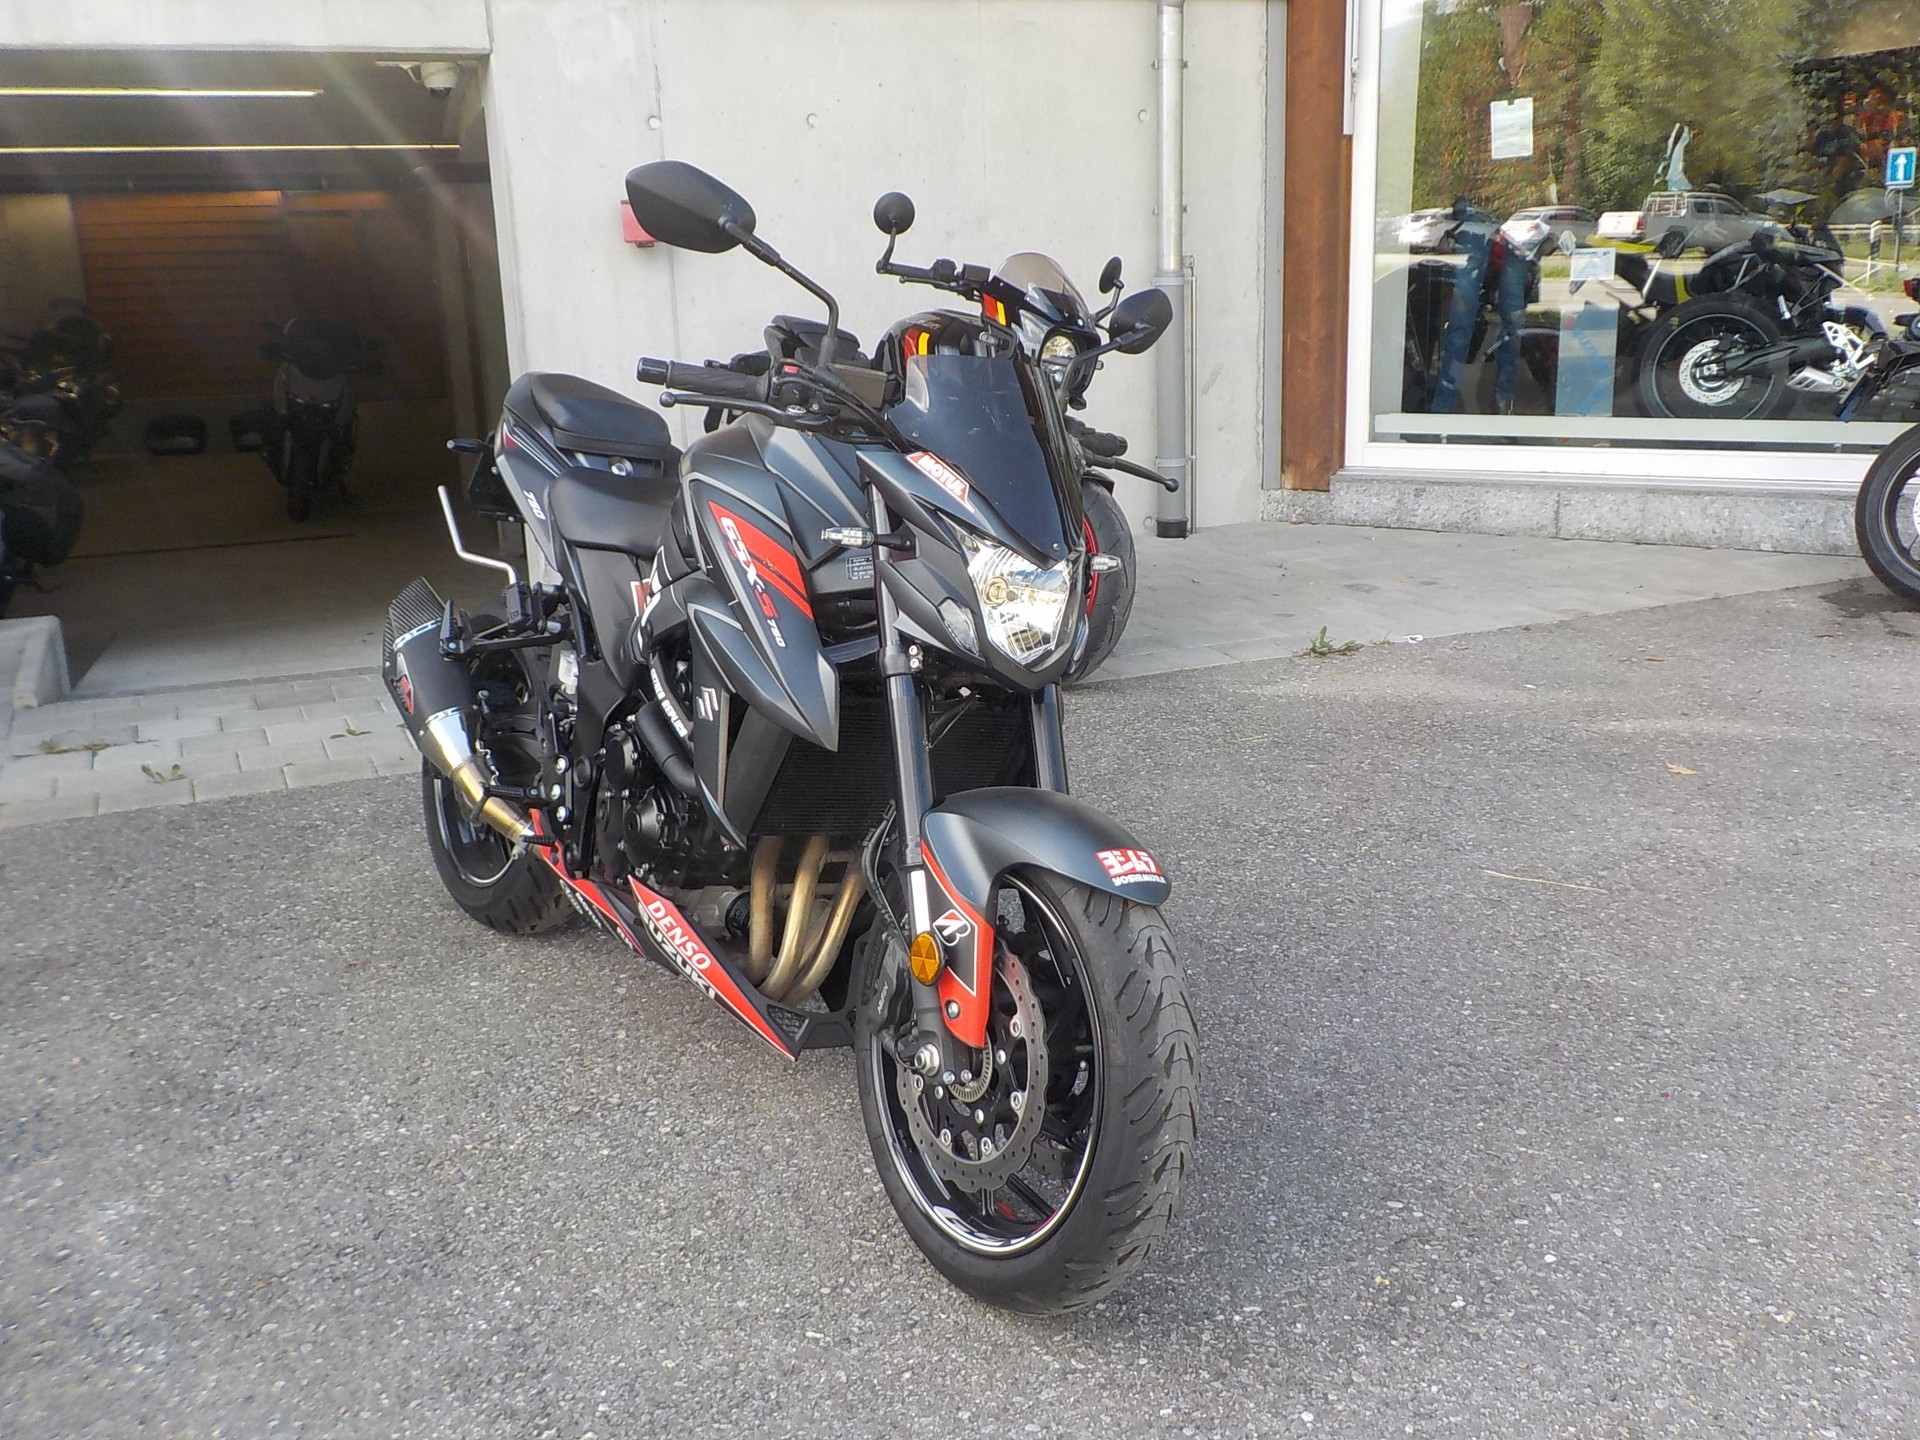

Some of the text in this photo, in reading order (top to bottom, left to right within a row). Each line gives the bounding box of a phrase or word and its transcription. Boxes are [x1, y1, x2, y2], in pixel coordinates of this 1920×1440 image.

[917, 454, 966, 496] MOTUL
[523, 490, 546, 520] 750
[647, 900, 712, 970] DENSO
